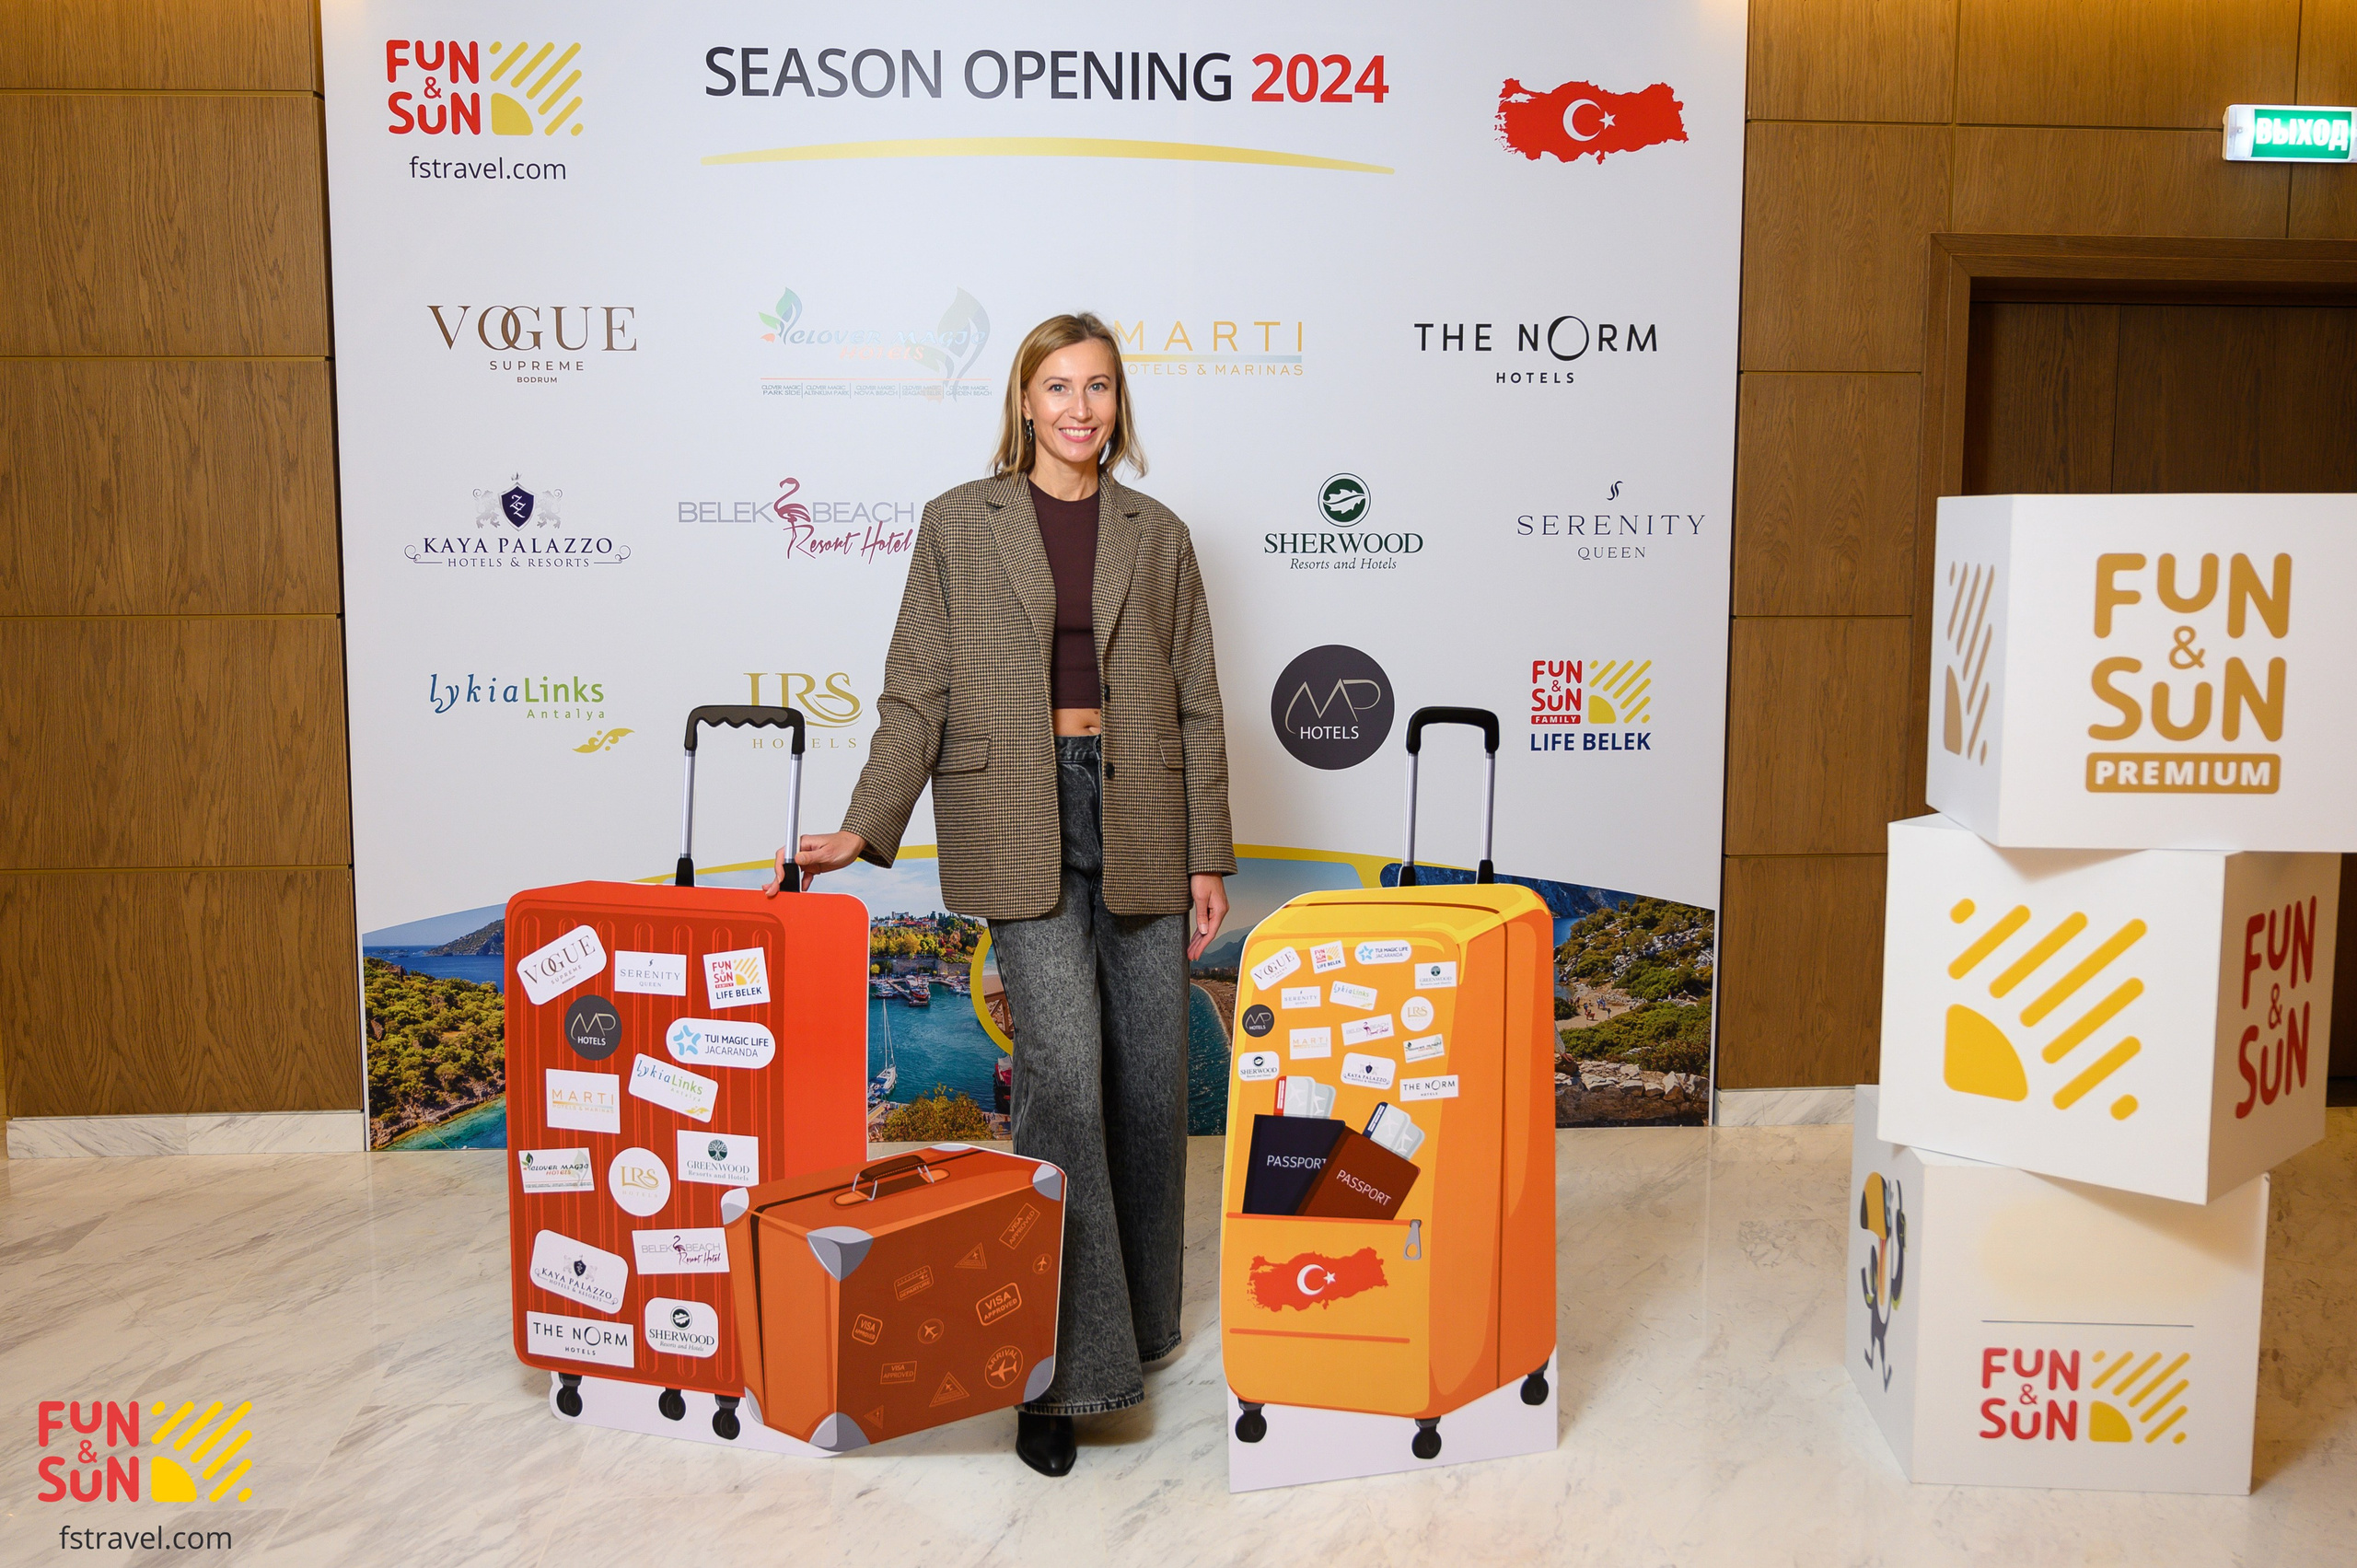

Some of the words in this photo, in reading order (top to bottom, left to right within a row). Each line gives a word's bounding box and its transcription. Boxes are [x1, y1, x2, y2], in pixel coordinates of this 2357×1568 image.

[386, 40, 480, 85] FUN
[704, 46, 942, 99] SEASON
[964, 49, 1232, 102] OPENING
[1250, 52, 1390, 104] 2024
[424, 75, 442, 99] &
[2256, 117, 2349, 152] ВЫХОД
[409, 156, 566, 180] fstravel.com
[426, 305, 637, 352] VOGUE
[789, 329, 882, 345] CLOVER
[890, 329, 987, 346] MAGIC
[1114, 319, 1303, 353] MARTI
[1413, 322, 1492, 352] THE
[1518, 315, 1658, 362] NORM
[489, 360, 585, 372] SUPREME
[1127, 364, 1188, 376] OTELS
[1196, 364, 1207, 376] &
[1214, 364, 1304, 377] MARINAS
[1495, 372, 1575, 384] HOTELS
[678, 501, 774, 523] BELEK
[812, 501, 914, 523] BEACH
[1516, 515, 1706, 536] SERENITY
[424, 537, 489, 554] KAYA
[497, 537, 613, 554] PALAZZO
[783, 524, 861, 560] Resort
[860, 520, 914, 564] Hotel
[1263, 532, 1424, 554] SHERWOOD
[447, 558, 503, 568] HOTELS
[510, 557, 521, 568] &
[528, 558, 590, 568] RESORTS
[1577, 546, 1646, 561] QUEEN
[1290, 558, 1329, 570] Resorts
[1333, 558, 1356, 570] and
[1360, 558, 1397, 570] Hotels
[2094, 552, 2293, 639] FUN
[2169, 625, 2205, 669] &
[1531, 659, 1583, 684] FUN
[527, 708, 605, 721] Antalya
[1284, 678, 1381, 735] MP
[1535, 715, 1577, 724] FAMILY
[1300, 725, 1360, 740] HOTELS
[1530, 733, 1575, 751] LIFE
[1583, 732, 1652, 751] BELEK
[752, 738, 857, 749] HOELS
[2094, 760, 2271, 787] PREMIUM
[524, 935, 596, 984] VOGUE
[2241, 894, 2317, 1010] FUN
[620, 968, 681, 981] SERENITY
[712, 960, 733, 972] FUN
[1253, 950, 1295, 981] VOGUE
[715, 990, 734, 1000] LIFE
[735, 986, 763, 997] BELEK
[577, 1036, 607, 1046] HOTELS
[704, 1033, 720, 1043] TUI
[721, 1035, 749, 1046] MAGIC
[750, 1038, 770, 1048] LIFE
[704, 1045, 759, 1058] JACARANDA
[1239, 1067, 1278, 1075] SHERWOOD
[1403, 1083, 1421, 1091] THE
[1424, 1079, 1456, 1091] NORM
[552, 1088, 614, 1106] MARTI
[686, 1160, 750, 1174] GREENWOOD
[620, 1165, 660, 1191] LRS
[1336, 1169, 1392, 1206] PASSPORT
[1008, 1216, 1024, 1233] VISA
[1009, 1210, 1035, 1245] APPROVED
[641, 1244, 673, 1253] BELEK
[686, 1242, 721, 1252] BEACH
[541, 1267, 565, 1283] KAYA
[568, 1277, 613, 1300] PALAZZO
[899, 1280, 932, 1299] DEPARTURE
[983, 1297, 1018, 1321] APPROVED
[984, 1291, 1012, 1310] VISA
[532, 1321, 563, 1339] THE
[573, 1326, 629, 1347] NORM
[860, 1318, 876, 1333] VISA
[649, 1328, 715, 1346] SHERWOOD
[564, 1346, 597, 1356] HOTELS
[987, 1348, 1018, 1371] ARRIVAL
[883, 1370, 914, 1378] APPROVED
[891, 1364, 905, 1372] VISA
[1982, 1347, 2080, 1392] FUN
